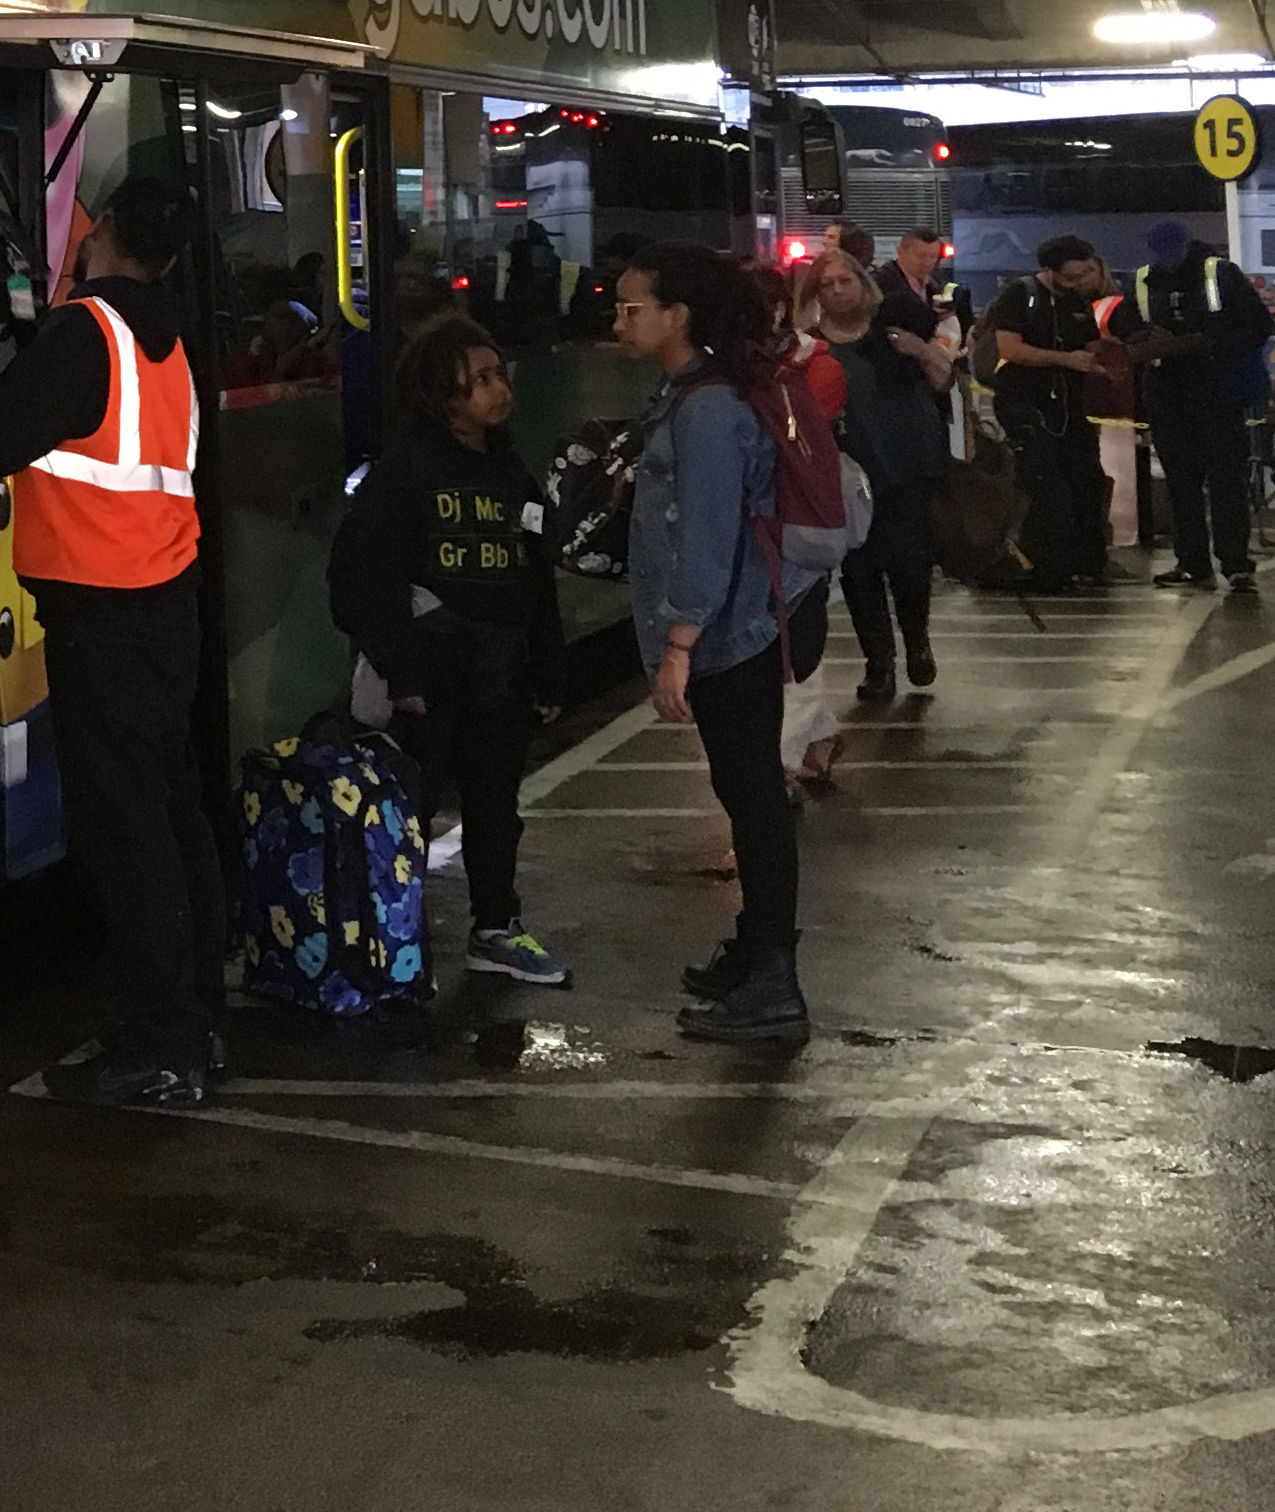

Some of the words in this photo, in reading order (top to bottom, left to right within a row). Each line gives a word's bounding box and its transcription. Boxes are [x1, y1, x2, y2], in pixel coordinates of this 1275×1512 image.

[1202, 117, 1246, 158] 15
[436, 491, 461, 523] Dj
[474, 495, 504, 522] Mc
[439, 541, 468, 568] Gr
[480, 542, 509, 569] Bb
